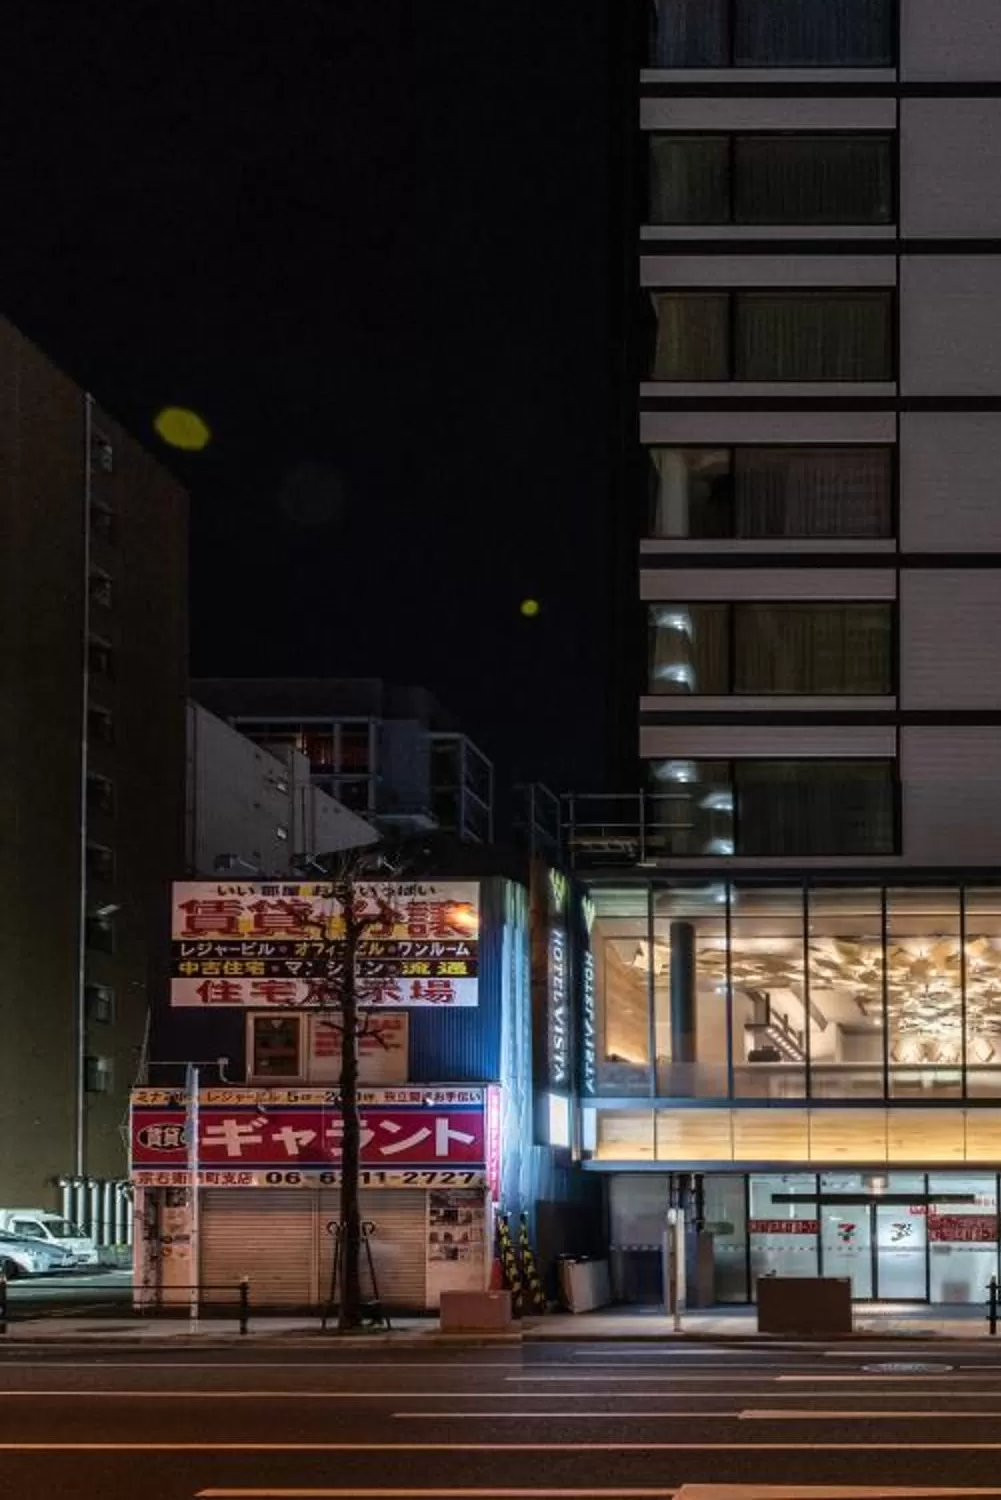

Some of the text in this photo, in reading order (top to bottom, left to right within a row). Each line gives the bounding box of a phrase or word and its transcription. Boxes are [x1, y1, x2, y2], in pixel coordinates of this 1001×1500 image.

[552, 930, 565, 1081] HOTEL VISTA
[201, 1116, 476, 1157] ギャラント
[266, 1172, 476, 1185] 06-611-2727
